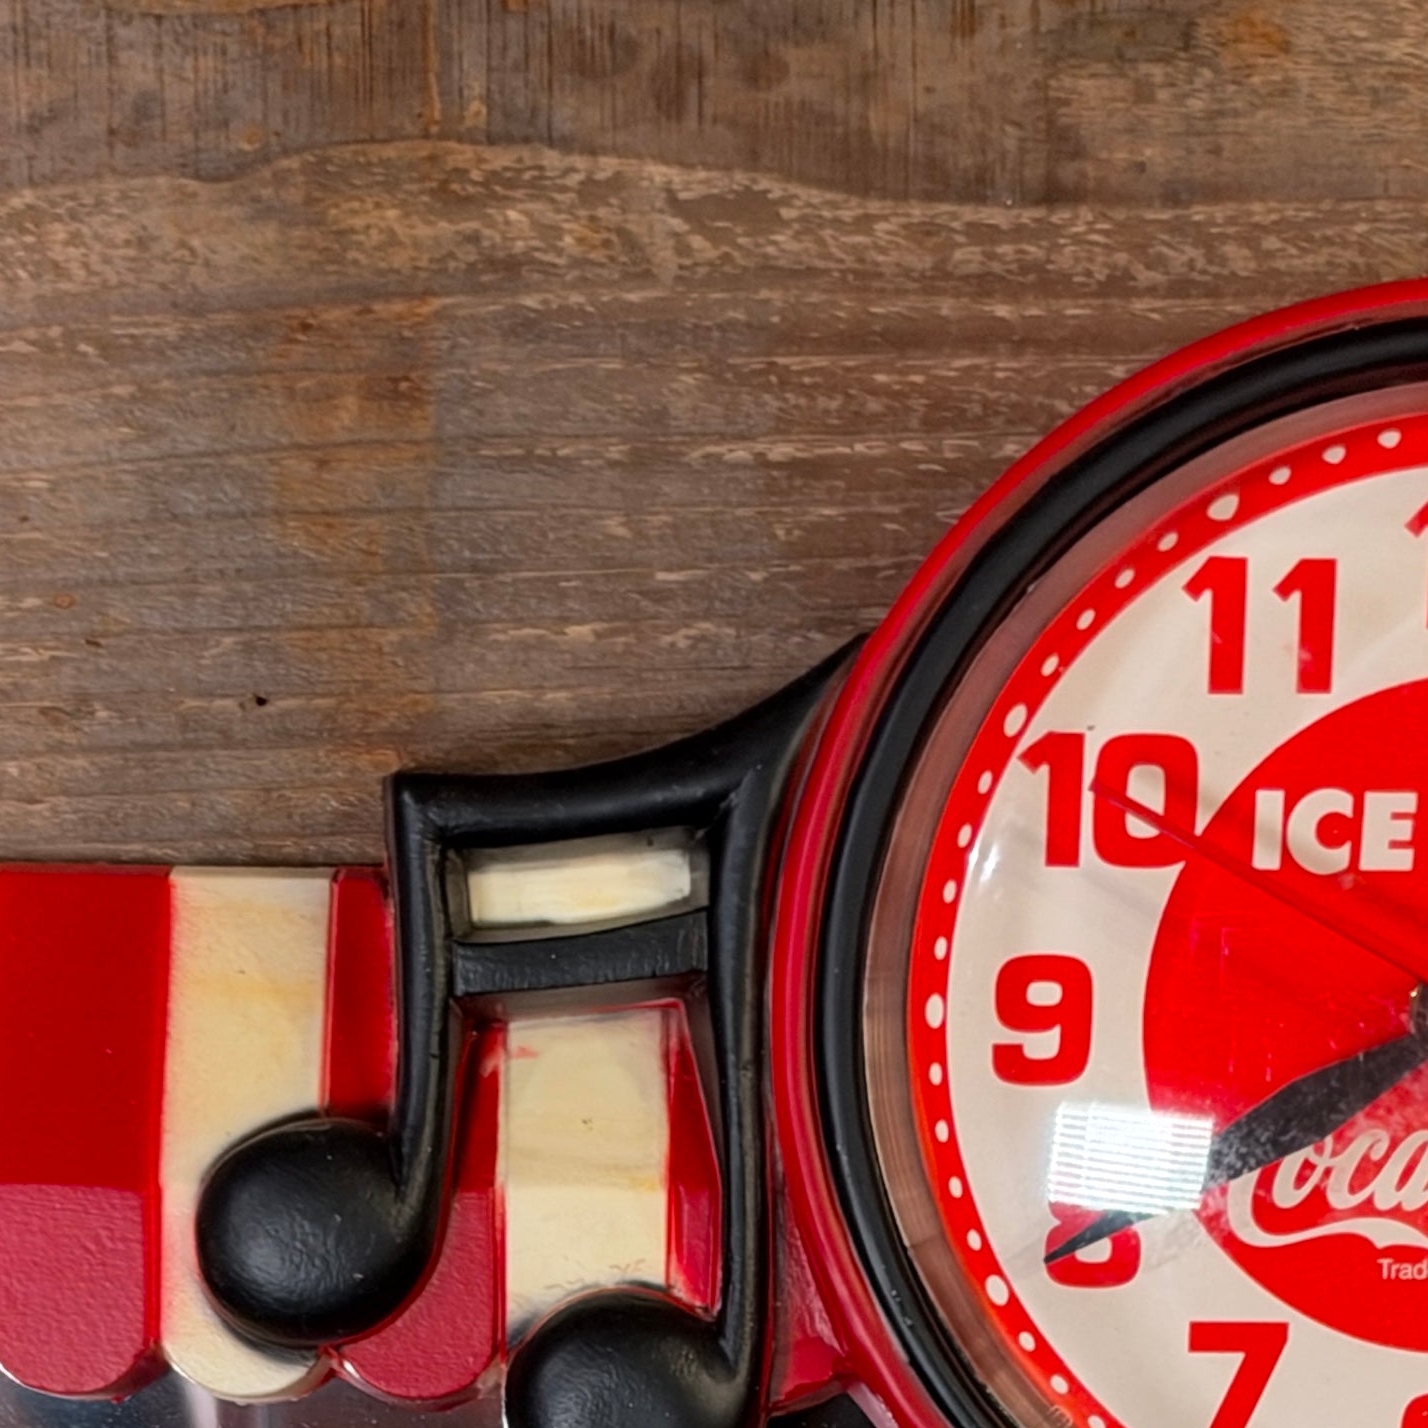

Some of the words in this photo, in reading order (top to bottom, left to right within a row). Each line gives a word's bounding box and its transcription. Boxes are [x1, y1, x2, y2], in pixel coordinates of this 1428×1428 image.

[1181, 555, 1340, 695] 11
[1016, 730, 1201, 871] 10
[1250, 789, 1418, 874] ICE
[991, 953, 1093, 1086] 9
